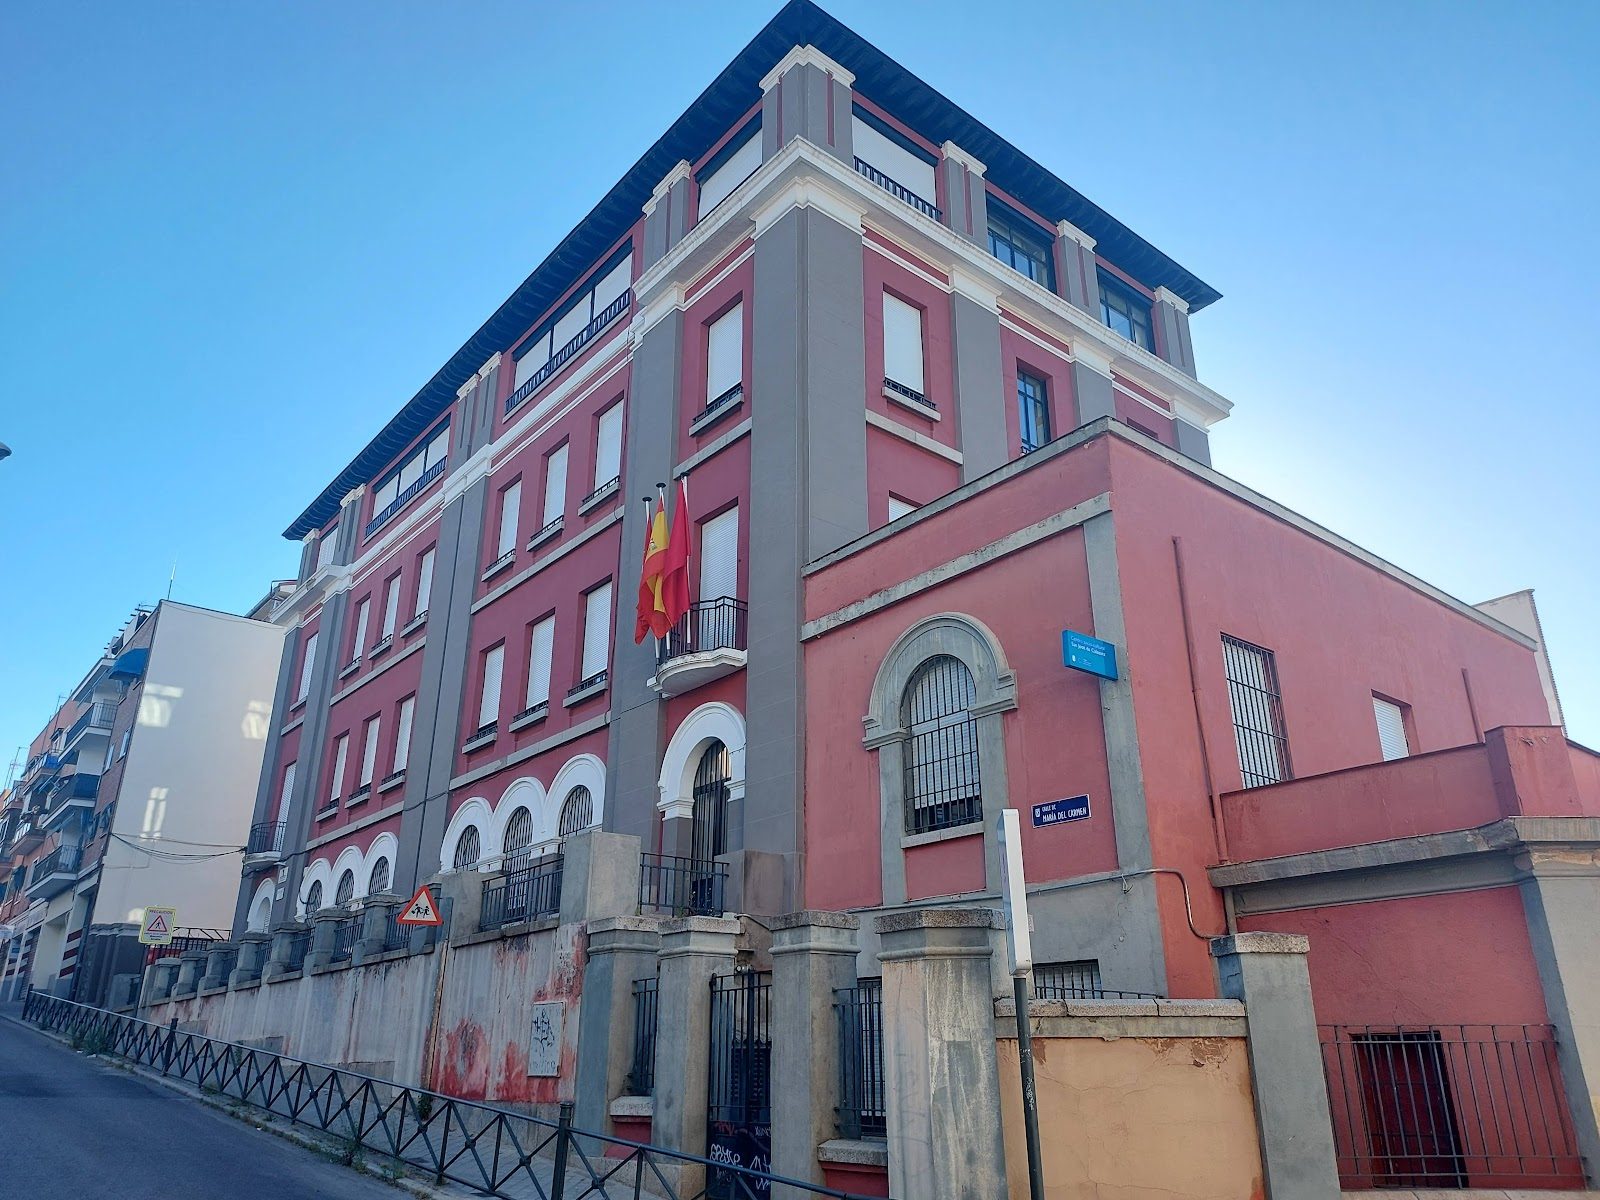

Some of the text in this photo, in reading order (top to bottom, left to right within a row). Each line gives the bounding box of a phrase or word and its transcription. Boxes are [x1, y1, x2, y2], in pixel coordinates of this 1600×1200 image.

[1042, 806, 1087, 822] MARÍA DEL CARMEN
